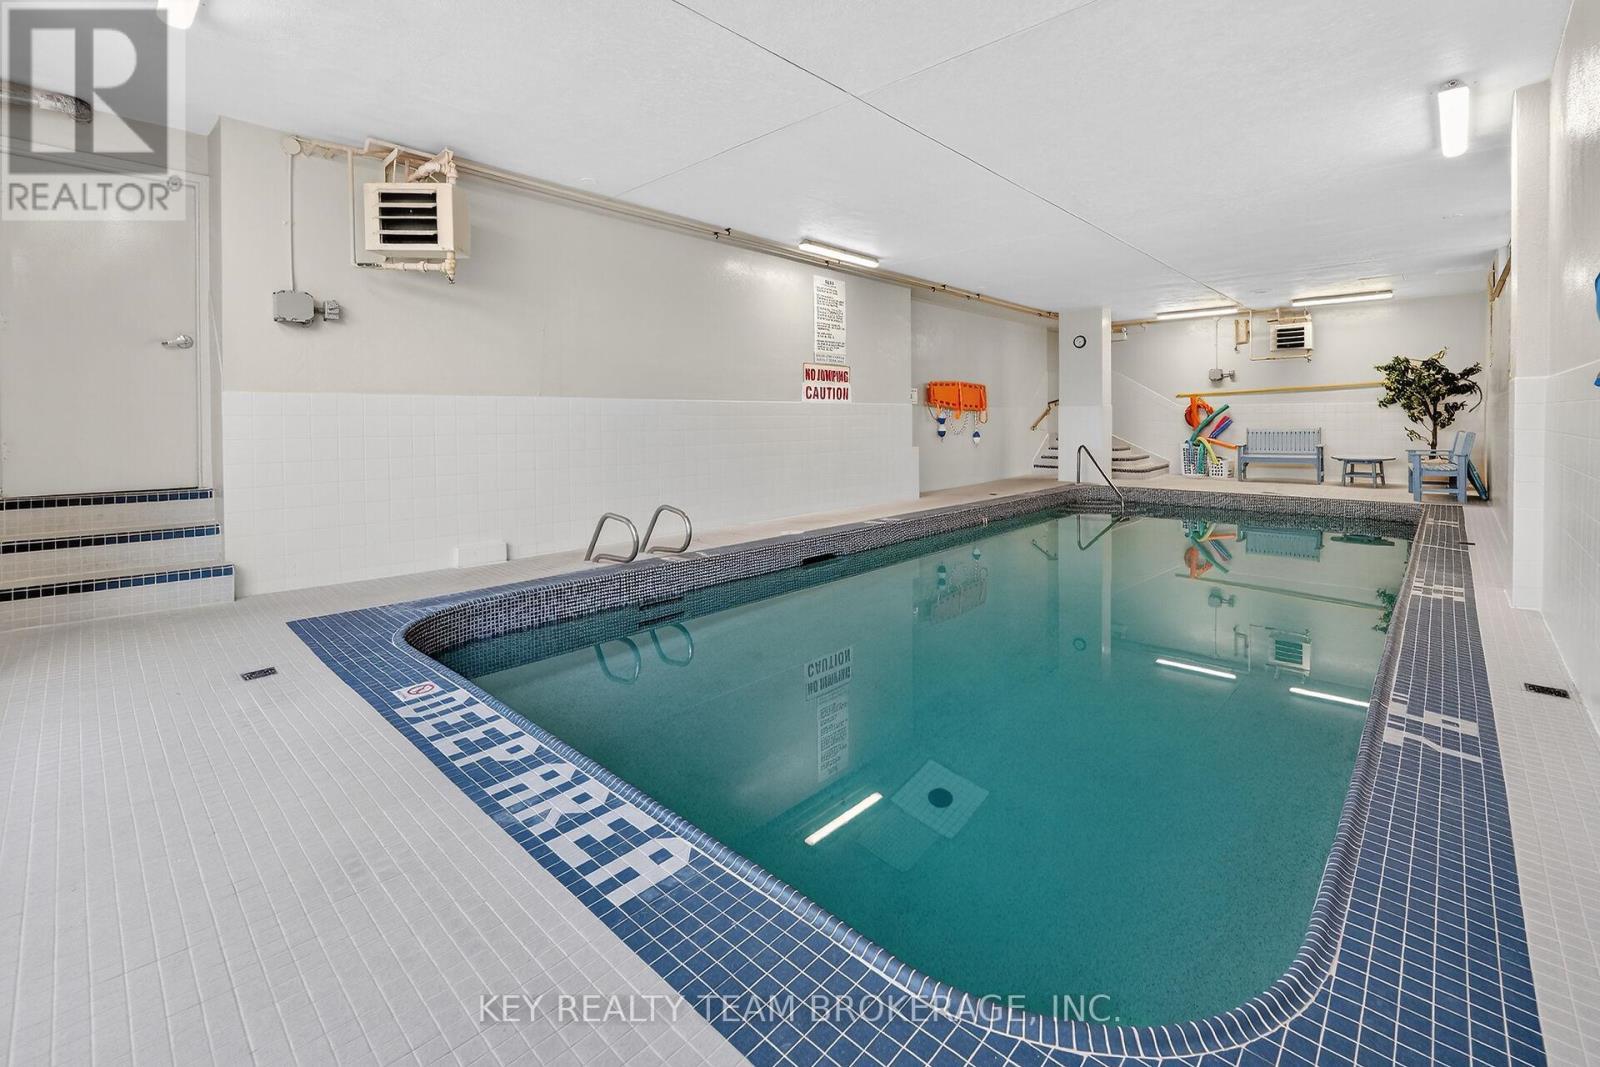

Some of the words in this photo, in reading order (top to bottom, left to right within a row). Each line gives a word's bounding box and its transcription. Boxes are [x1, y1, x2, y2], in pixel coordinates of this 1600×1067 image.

[805, 368, 816, 381] NO
[805, 386, 849, 400] CAUTION
[483, 764, 692, 905] AREA
